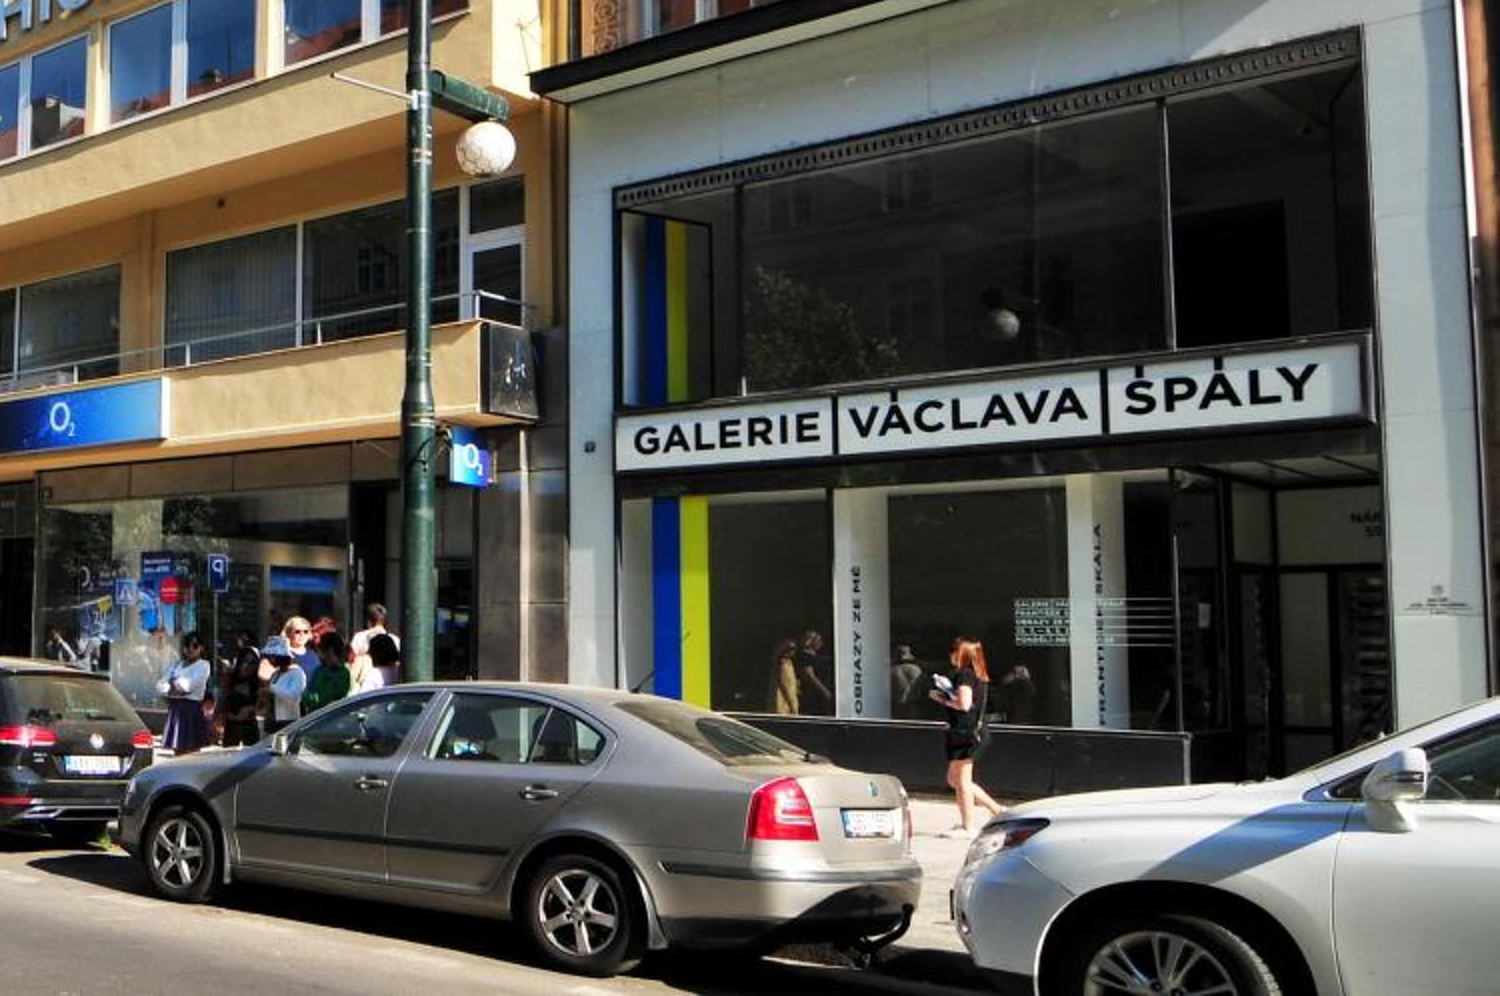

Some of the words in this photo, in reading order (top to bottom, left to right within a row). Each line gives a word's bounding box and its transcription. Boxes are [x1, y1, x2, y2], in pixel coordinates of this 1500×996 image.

[50, 402, 76, 437] O2
[634, 411, 820, 455] GALERIE
[848, 387, 1088, 438] VÁCLAVA
[1124, 357, 1319, 415] ŠPÁLY
[465, 443, 483, 475] O2
[853, 631, 864, 715] OBRAZY
